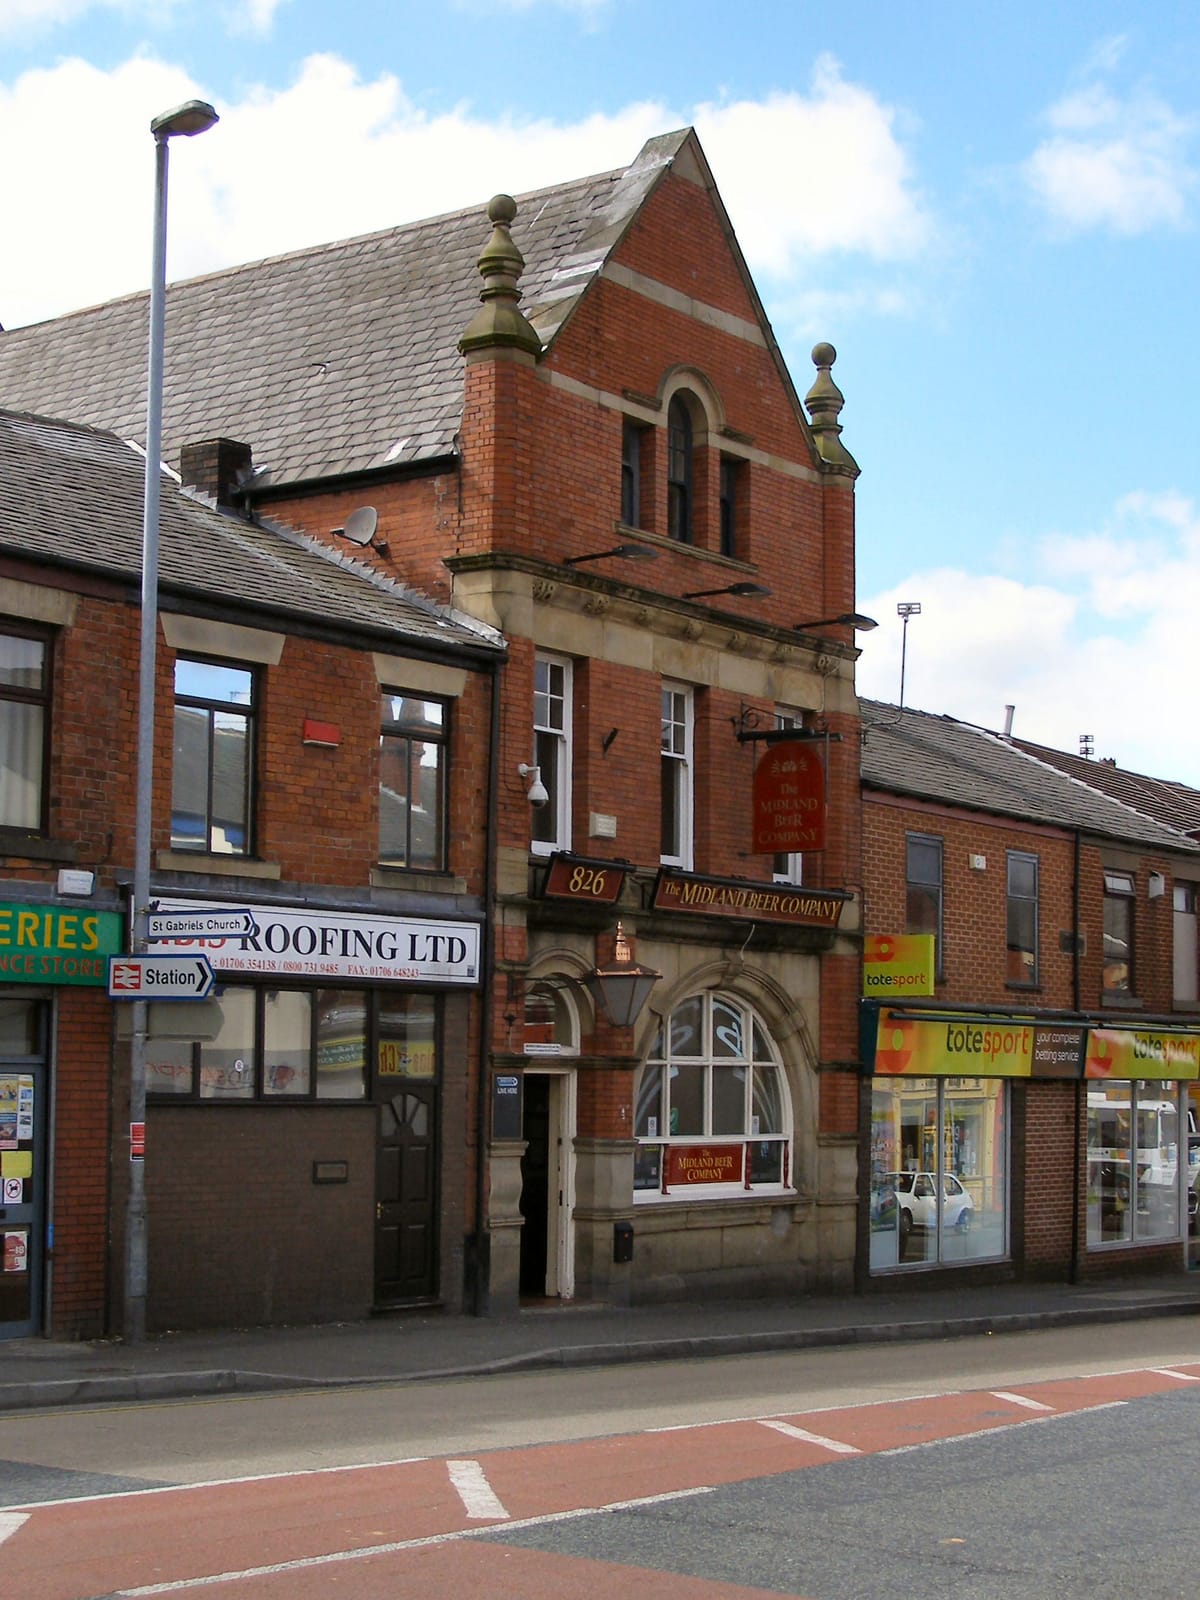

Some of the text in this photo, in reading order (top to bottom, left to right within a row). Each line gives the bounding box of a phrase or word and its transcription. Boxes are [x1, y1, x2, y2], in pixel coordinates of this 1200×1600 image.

[761, 798, 818, 814] MIDLAND
[758, 828, 817, 844] COMPANY
[569, 866, 608, 895] 826
[664, 881, 843, 921] The MIDLAND BEER COMPANY
[152, 919, 241, 931] St Gabriels Church
[239, 923, 400, 960] ROOFING
[408, 933, 467, 964] LTD
[40, 955, 104, 977] STORE
[145, 968, 196, 985] Station
[867, 972, 926, 988] totesport
[946, 1024, 1029, 1063] totesport
[1036, 1032, 1080, 1046] your complete
[1035, 1048, 1080, 1064] betting service
[1133, 1034, 1197, 1067] totesport
[678, 1155, 733, 1170] MIDLAND BEER
[687, 1168, 724, 1181] COMPANY
